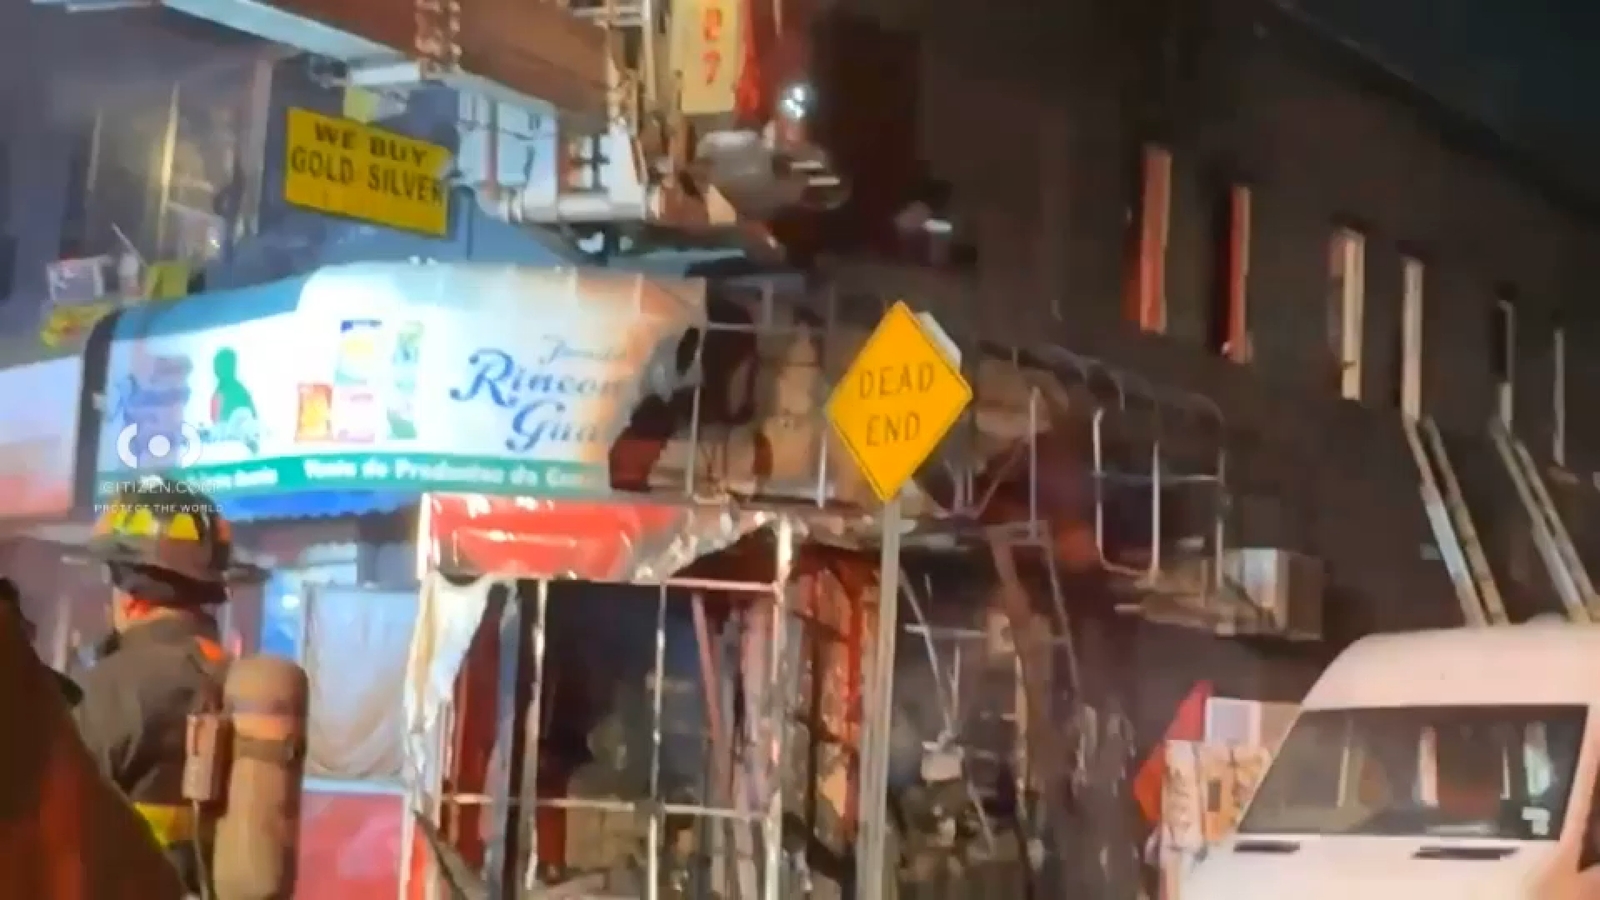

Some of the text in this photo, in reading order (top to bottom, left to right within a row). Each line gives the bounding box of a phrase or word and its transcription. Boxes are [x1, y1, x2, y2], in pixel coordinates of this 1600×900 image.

[314, 121, 426, 167] WE BUY
[291, 146, 444, 207] GOLD SILVER
[859, 362, 934, 399] DEAD
[866, 411, 920, 447] END
